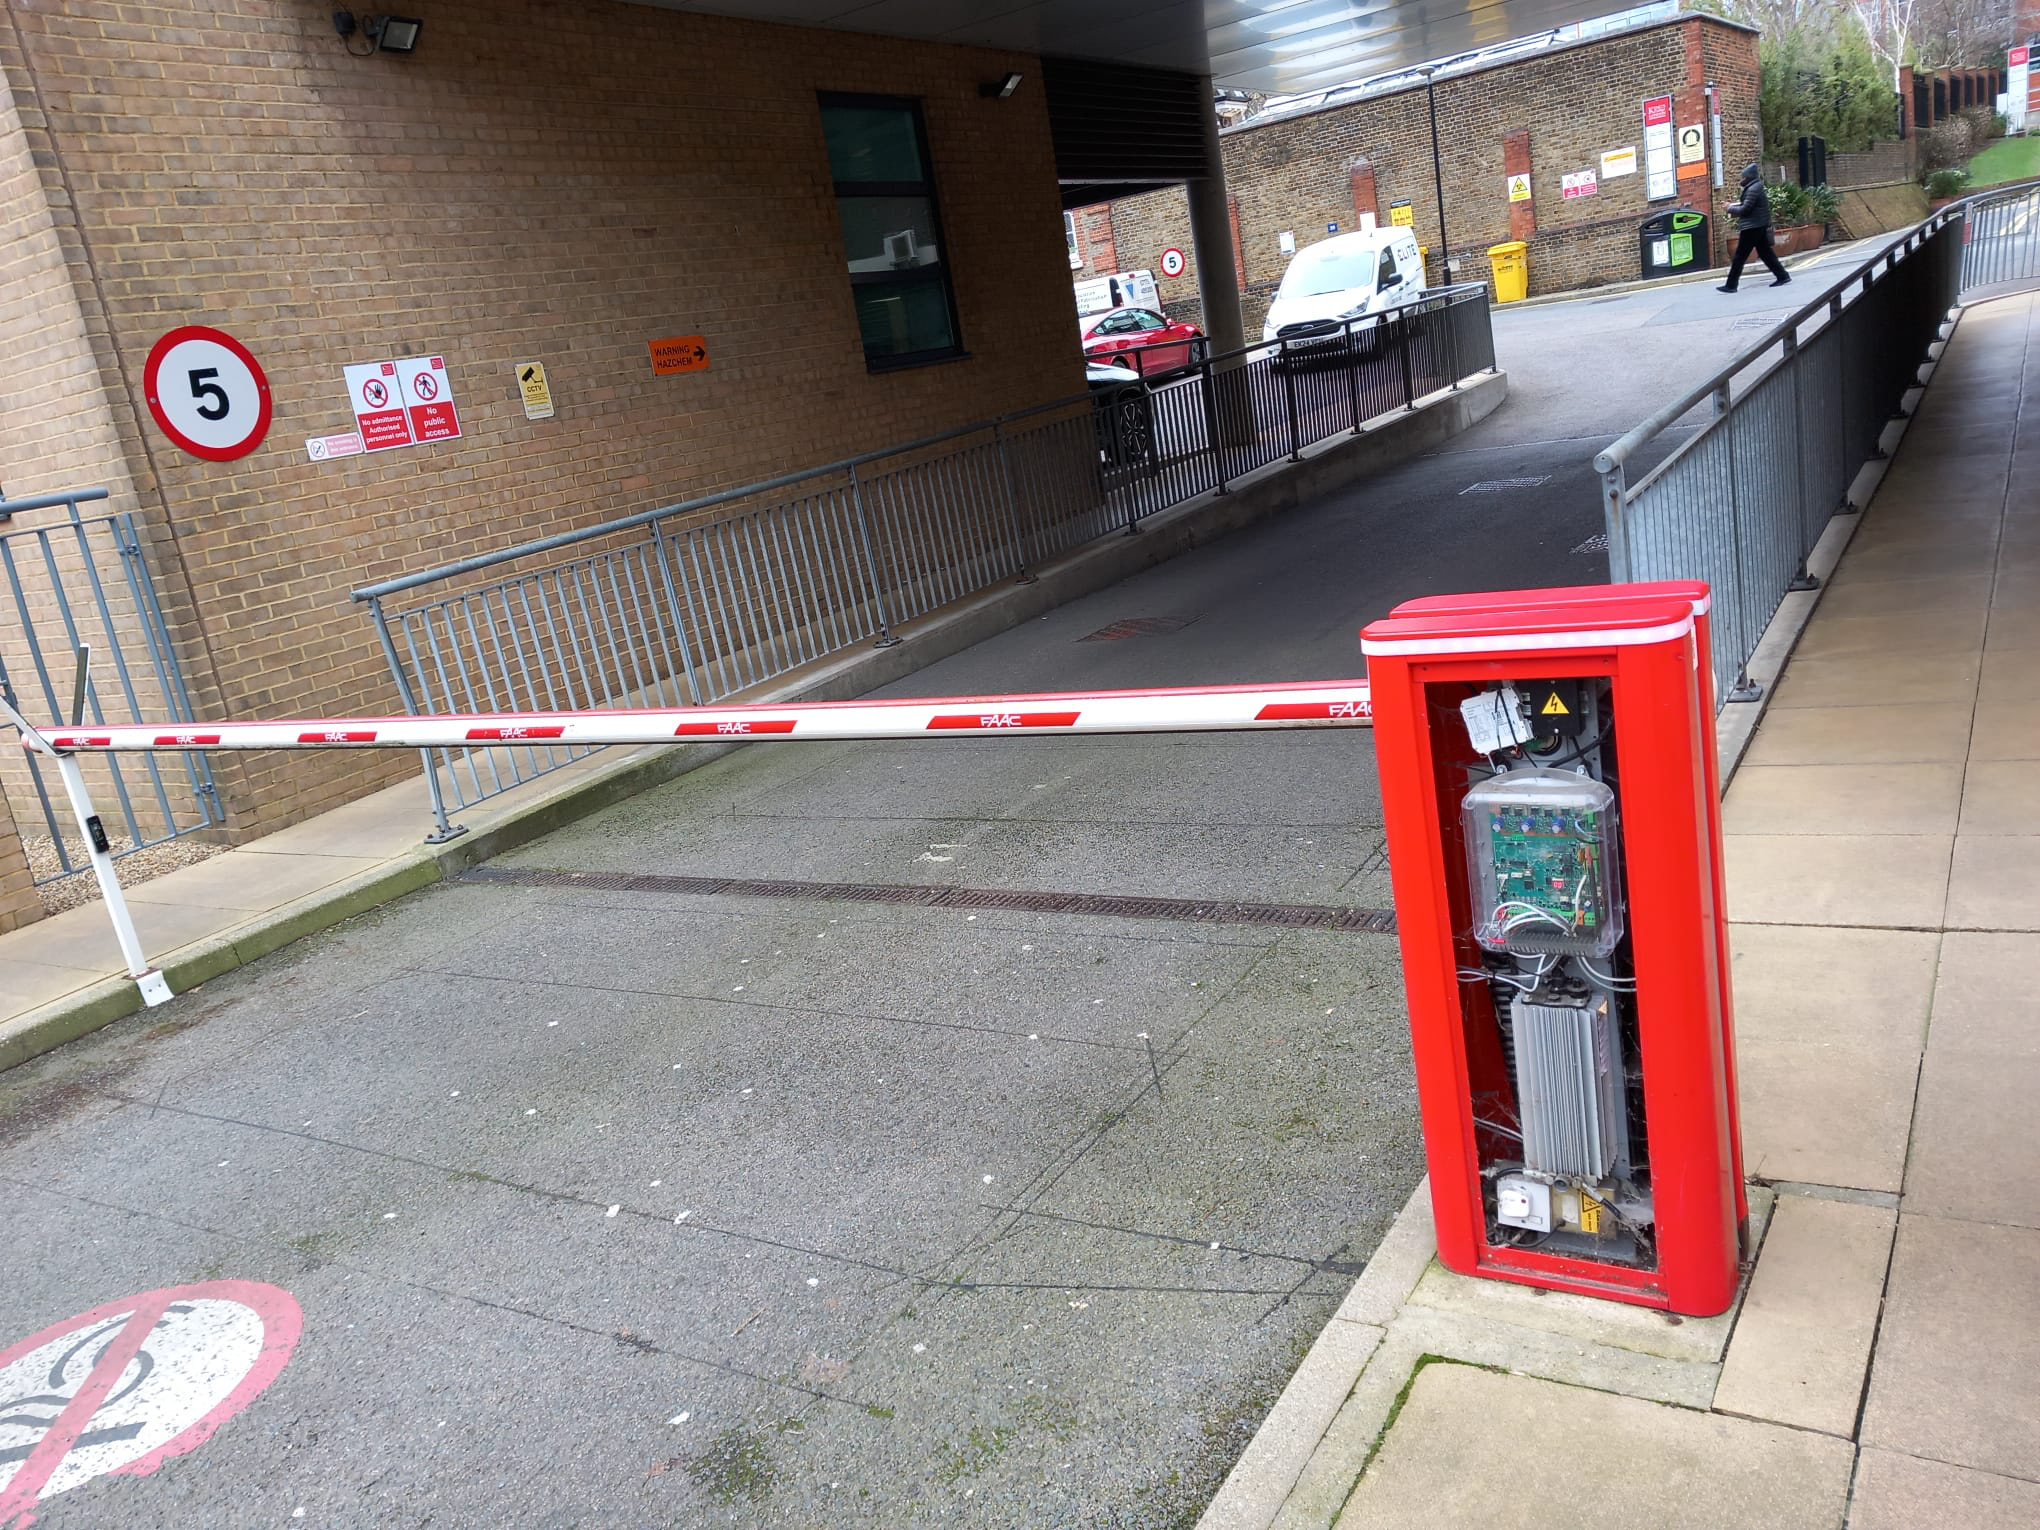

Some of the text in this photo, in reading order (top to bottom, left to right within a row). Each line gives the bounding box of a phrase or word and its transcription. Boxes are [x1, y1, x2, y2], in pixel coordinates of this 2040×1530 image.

[1397, 244, 1417, 261] ELITE
[1169, 257, 1177, 269] 5
[654, 345, 690, 357] WARNING
[656, 357, 692, 368] HAZCHEM
[188, 367, 230, 421] 5
[426, 407, 437, 415] No
[362, 415, 403, 426] No admittance
[423, 418, 446, 429] public
[369, 424, 400, 433] Authorised
[425, 428, 450, 438] access
[395, 431, 408, 440] only
[980, 714, 1022, 728] FAAC
[500, 727, 528, 738] FAAC
[717, 722, 751, 734] FAAC
[175, 735, 196, 744] FAAC
[325, 731, 348, 742] FAAC
